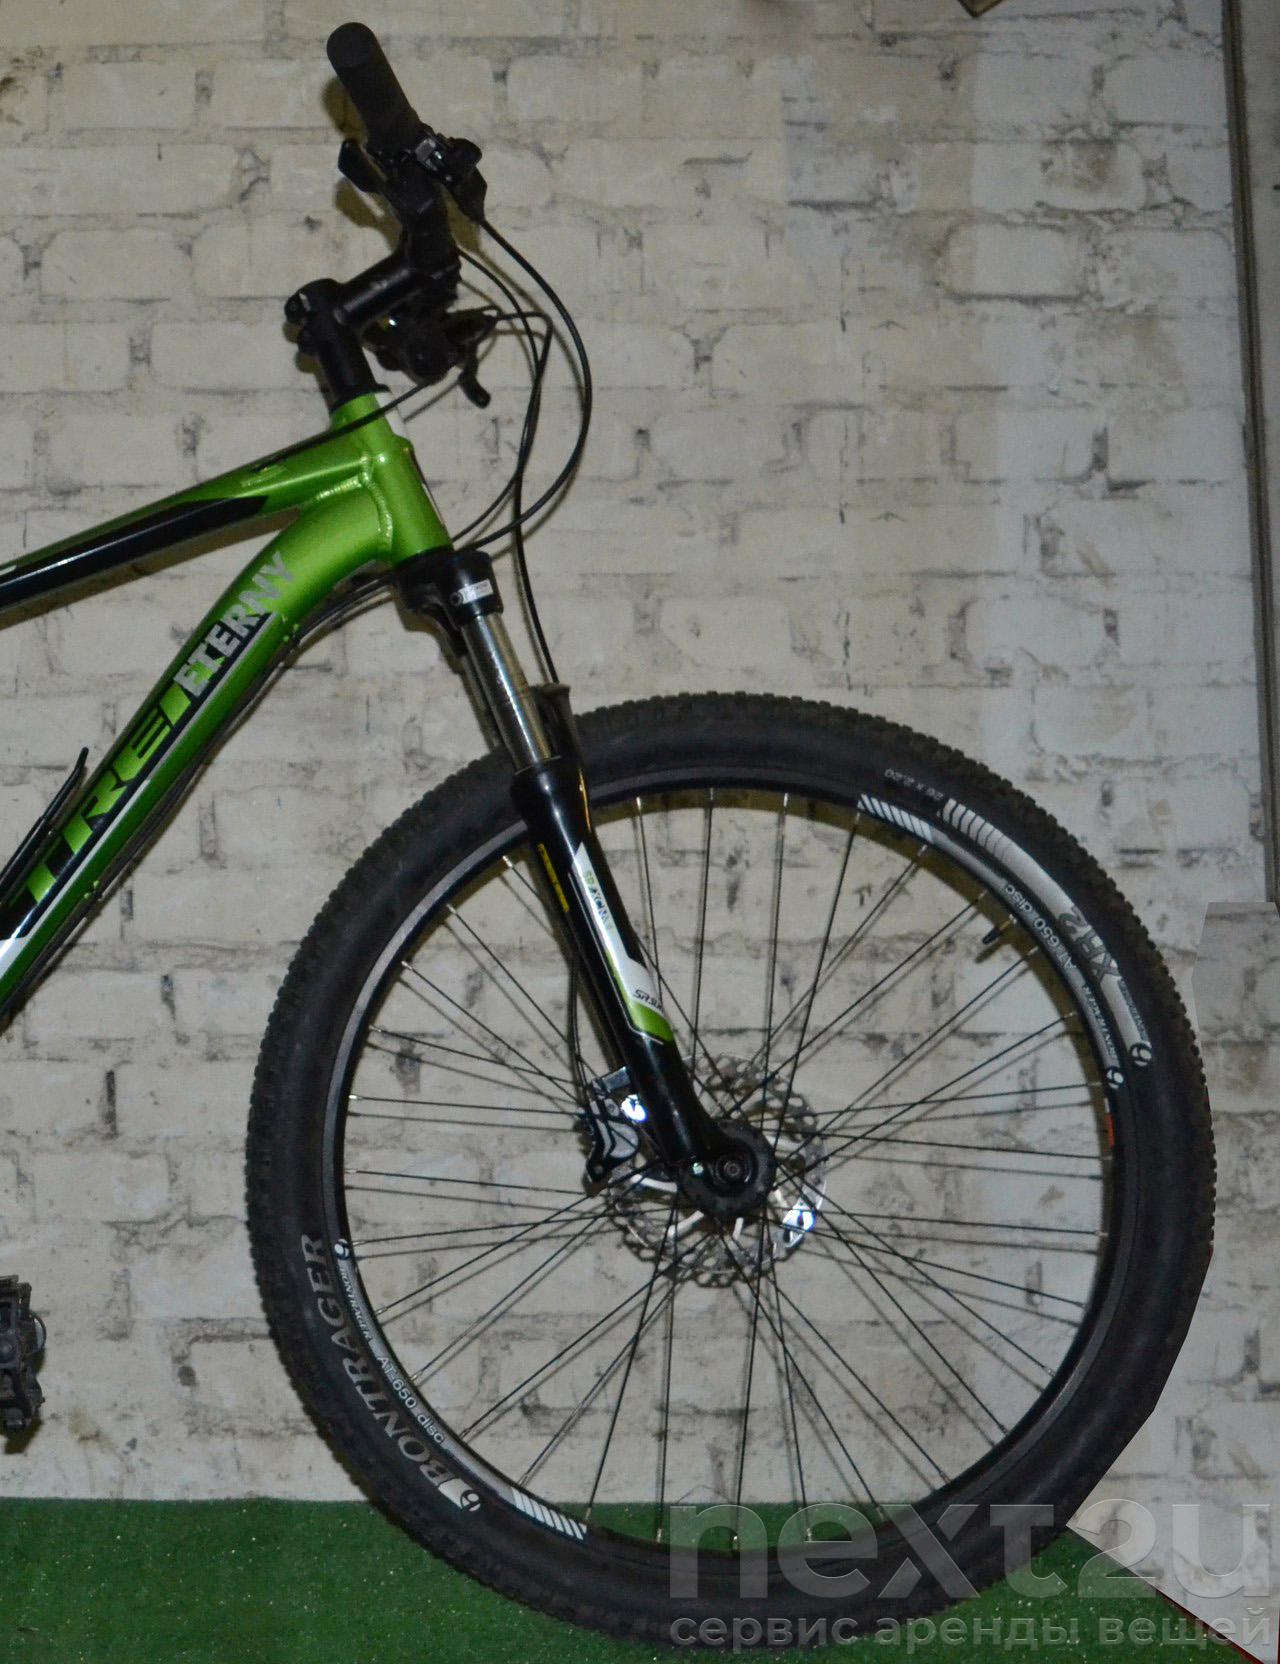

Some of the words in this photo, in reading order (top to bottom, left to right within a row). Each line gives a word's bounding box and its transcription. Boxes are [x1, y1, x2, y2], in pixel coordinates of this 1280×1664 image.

[300, 1233, 458, 1488] BONTRAGER
[376, 1355, 418, 1410] AT-650
[417, 1413, 446, 1444] disc
